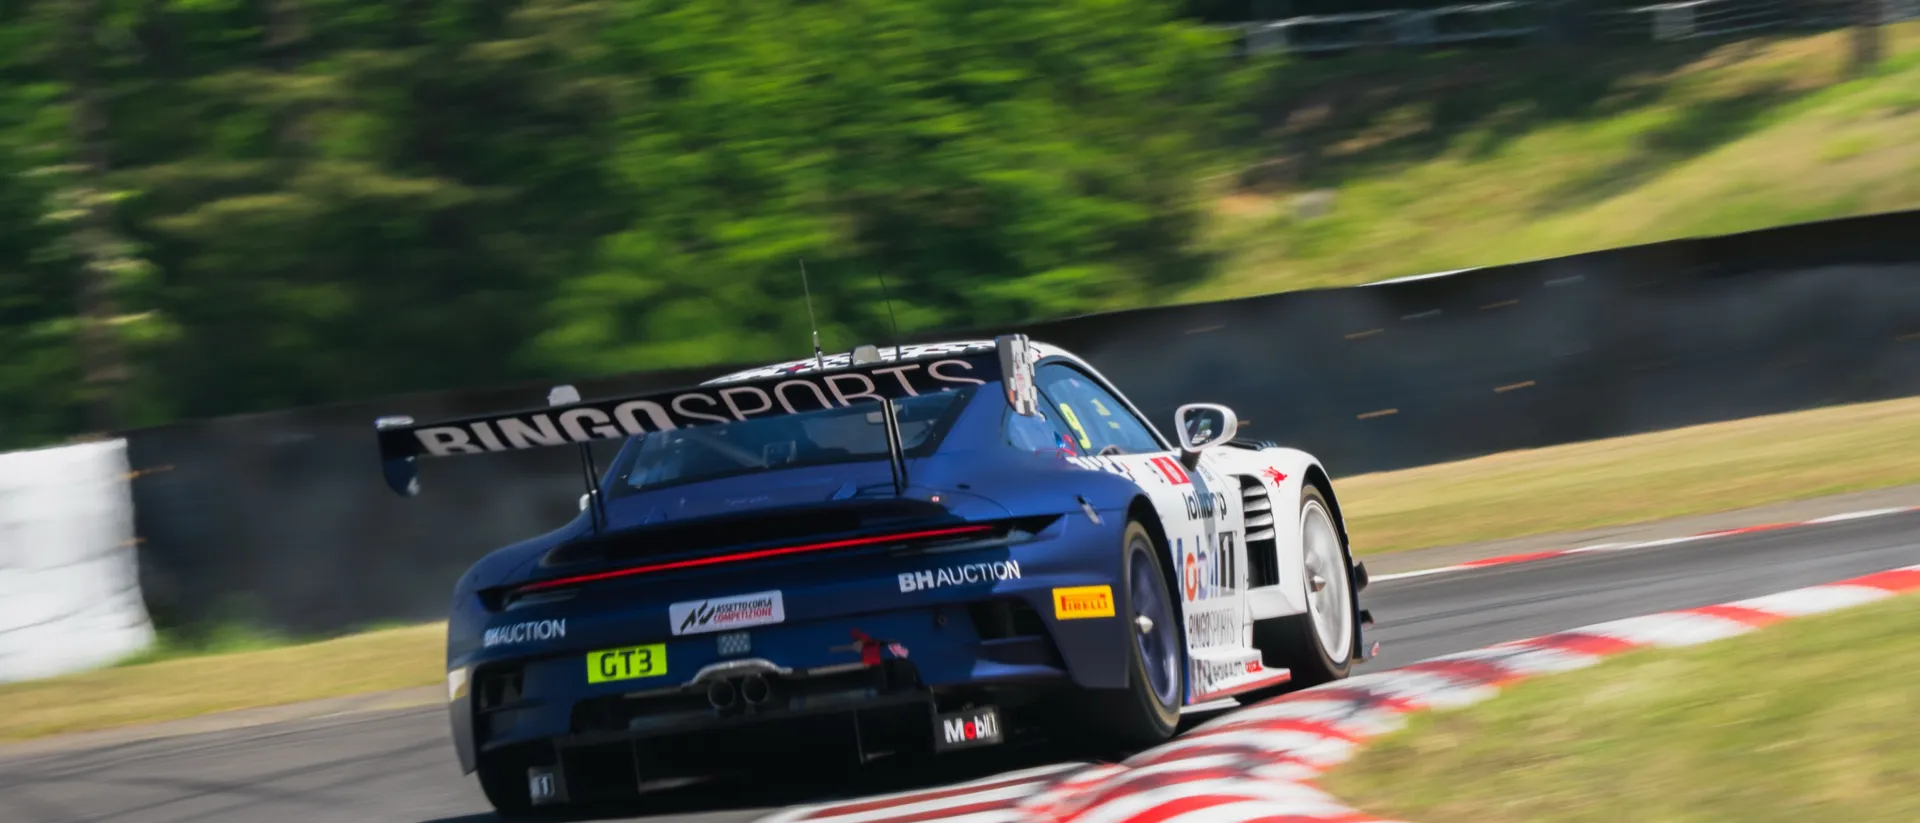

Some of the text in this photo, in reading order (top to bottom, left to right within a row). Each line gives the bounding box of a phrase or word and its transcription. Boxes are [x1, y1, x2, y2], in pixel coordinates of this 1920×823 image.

[1059, 402, 1092, 449] 9
[1060, 593, 1109, 612] PIRELLI
[713, 606, 773, 624] COMPETIZIONE
[600, 649, 653, 677] GT3
